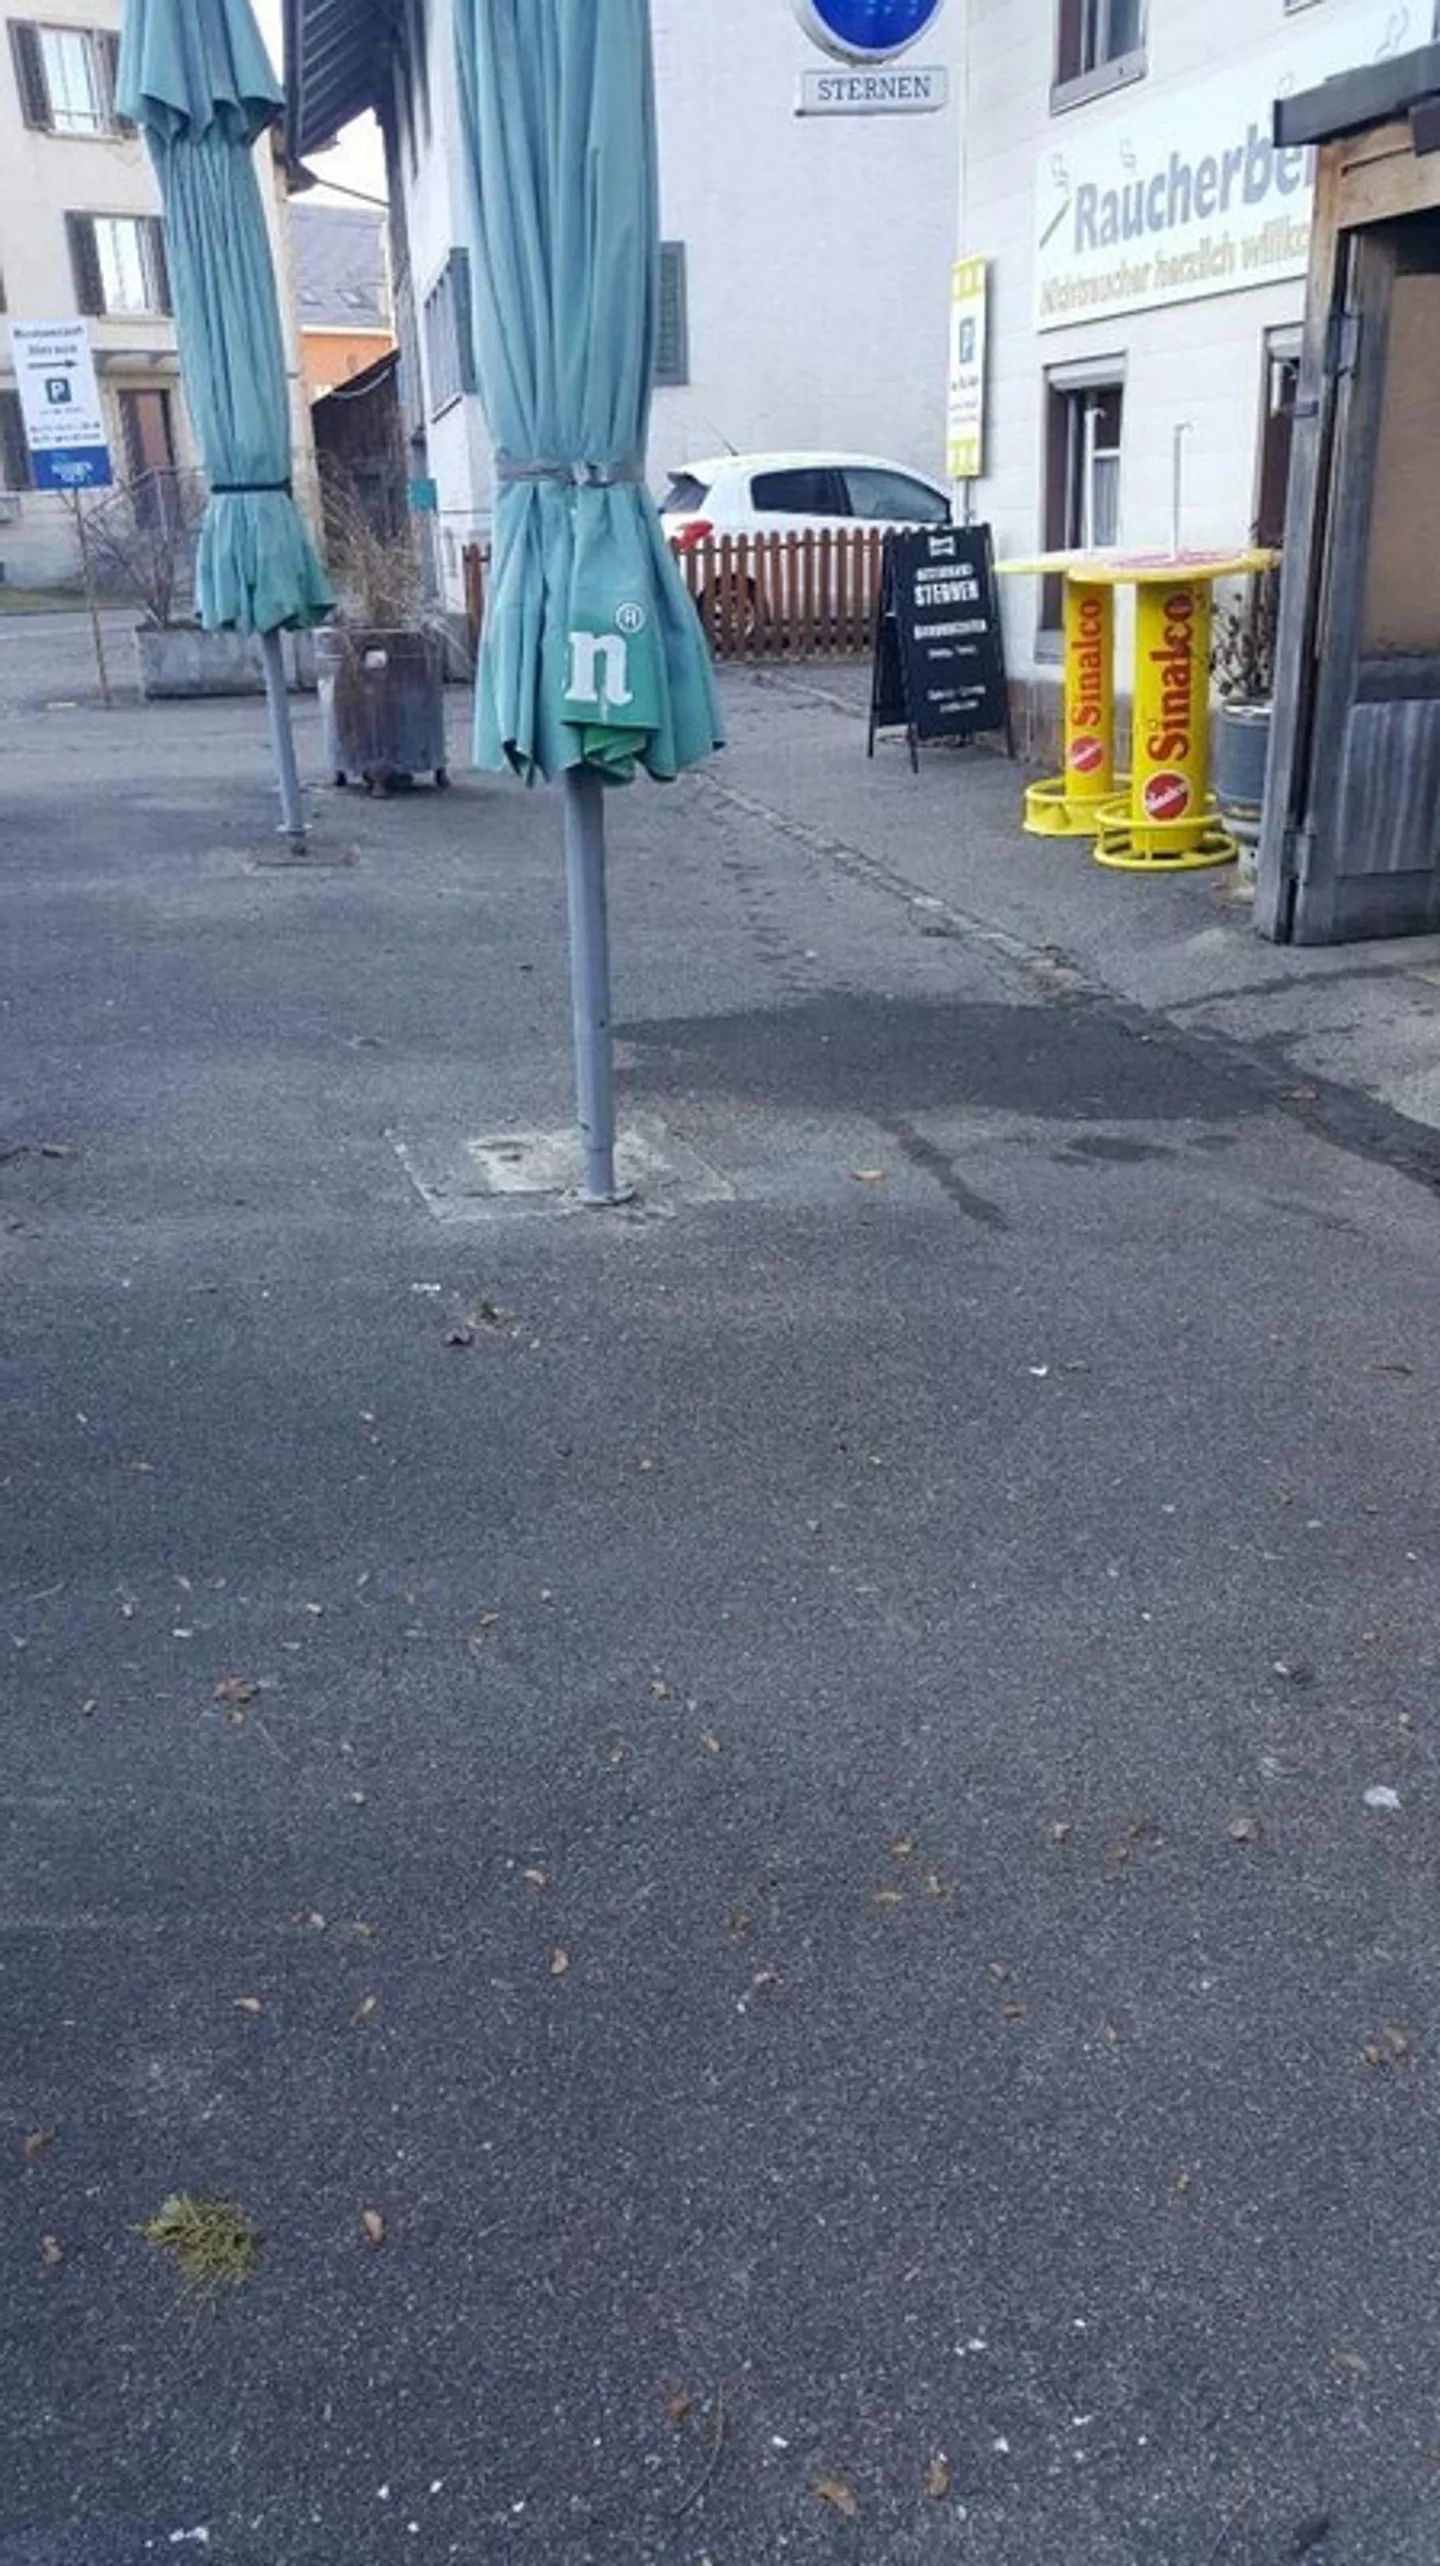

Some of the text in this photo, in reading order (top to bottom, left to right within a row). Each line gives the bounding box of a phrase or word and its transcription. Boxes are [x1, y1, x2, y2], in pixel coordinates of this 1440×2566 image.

[817, 75, 931, 101] STERNEN
[914, 579, 979, 607] STERNEN
[1071, 598, 1102, 727] Sinalco
[1147, 592, 1193, 762] Sinalco
